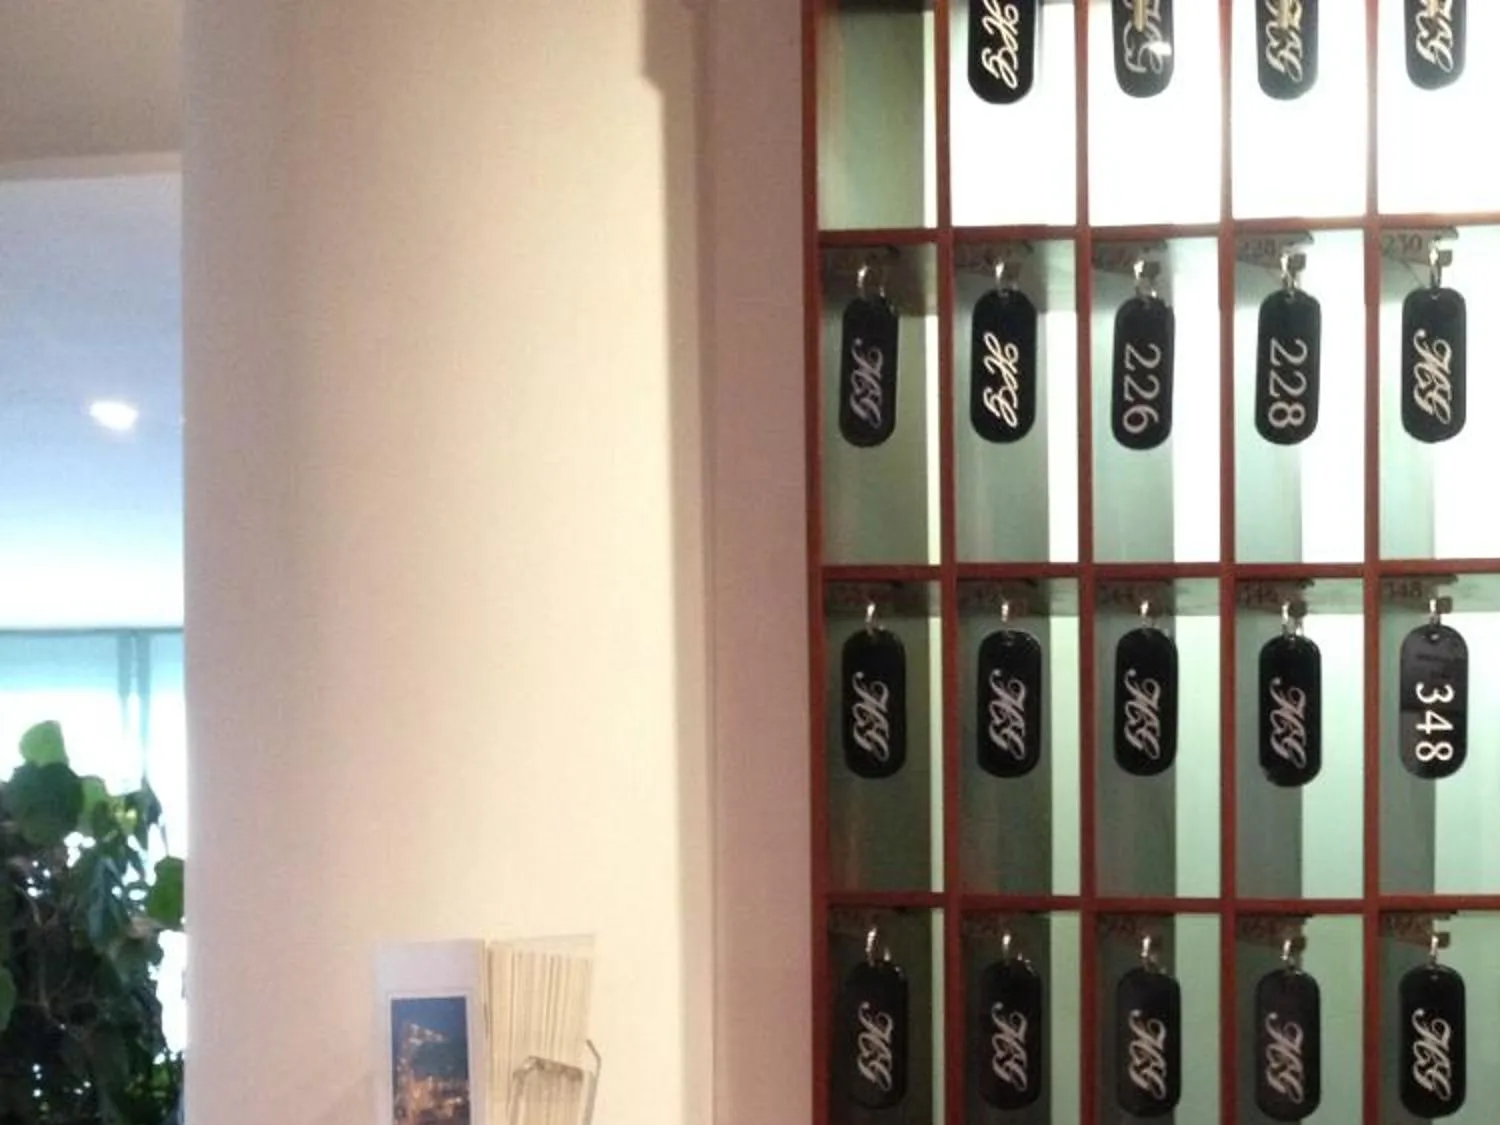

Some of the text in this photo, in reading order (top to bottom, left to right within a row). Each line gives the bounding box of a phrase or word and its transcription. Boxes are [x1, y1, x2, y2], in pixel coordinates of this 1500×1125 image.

[1122, 342, 1161, 434] 226
[1267, 337, 1308, 429] 228
[1414, 681, 1455, 762] 348
